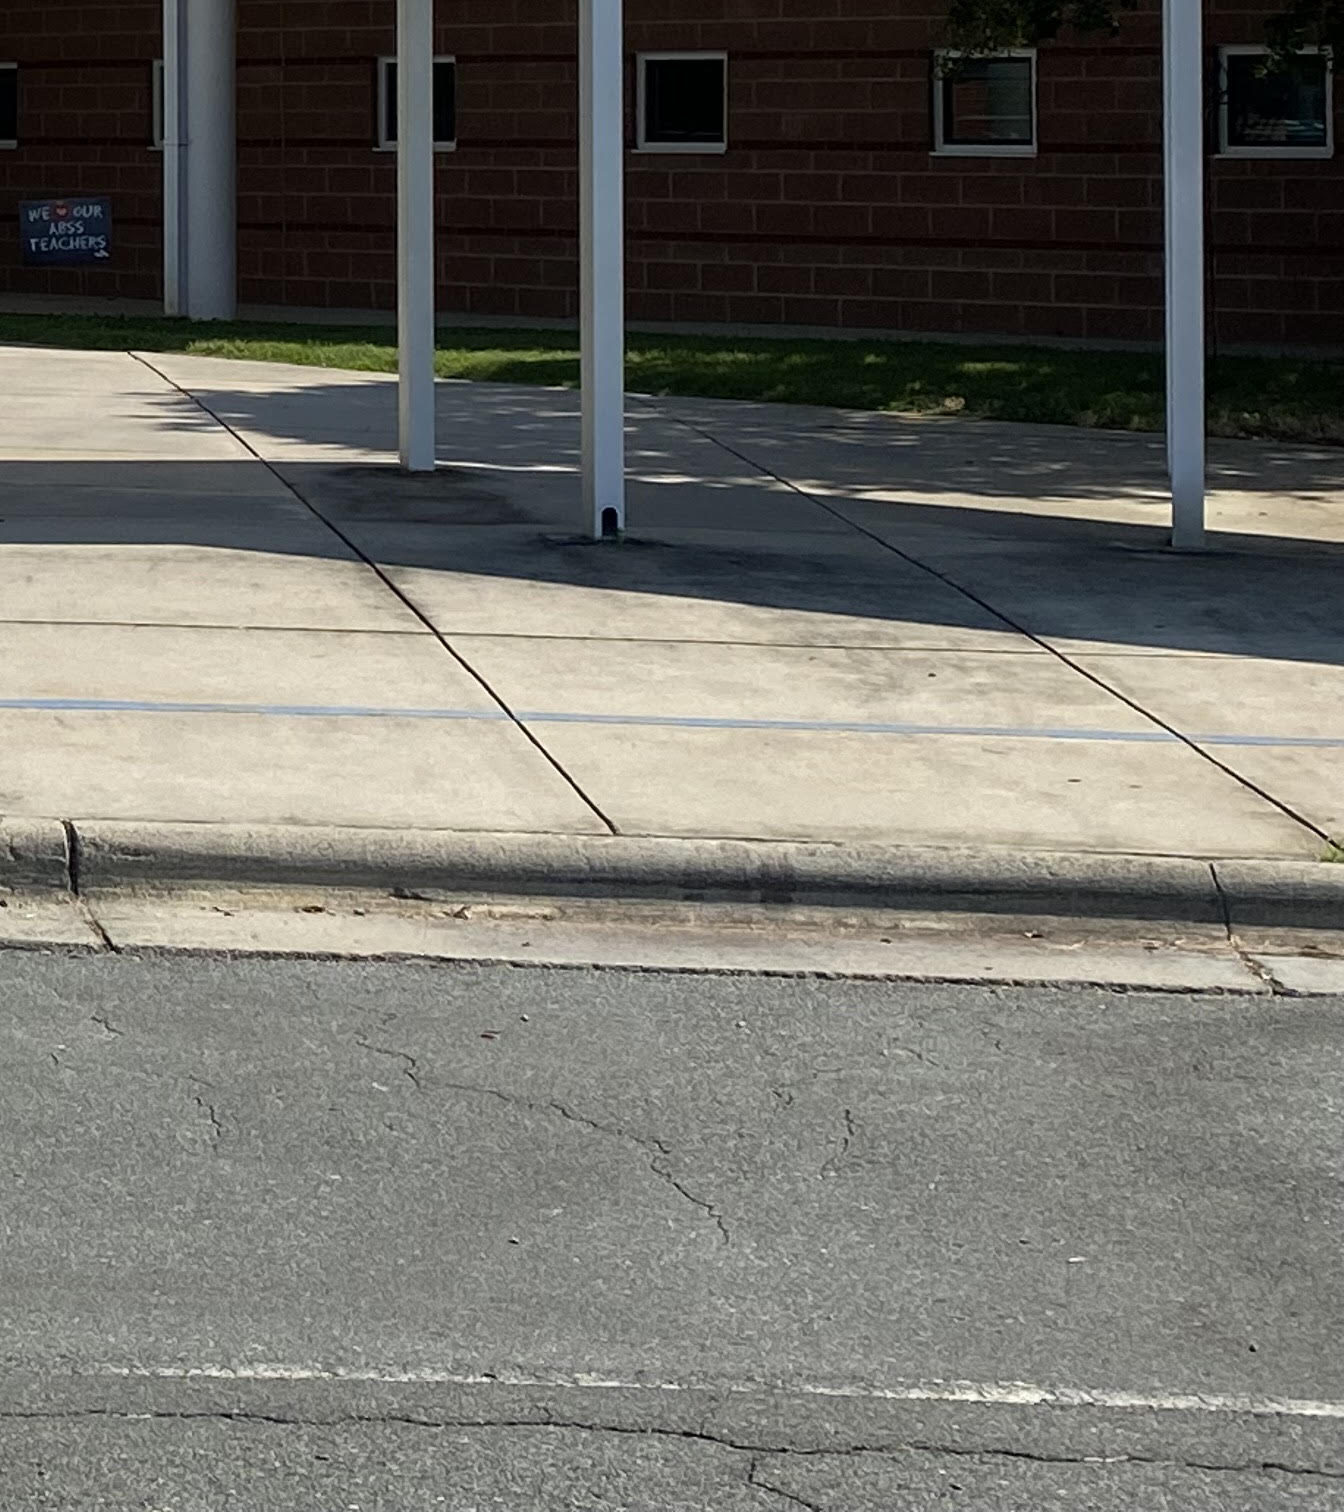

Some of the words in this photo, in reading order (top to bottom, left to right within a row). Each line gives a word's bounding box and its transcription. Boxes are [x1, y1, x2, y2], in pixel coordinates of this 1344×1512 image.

[28, 206, 50, 222] WE
[73, 205, 103, 218] OUR
[49, 220, 84, 235] ABSS
[30, 235, 106, 252] TEACHERS
